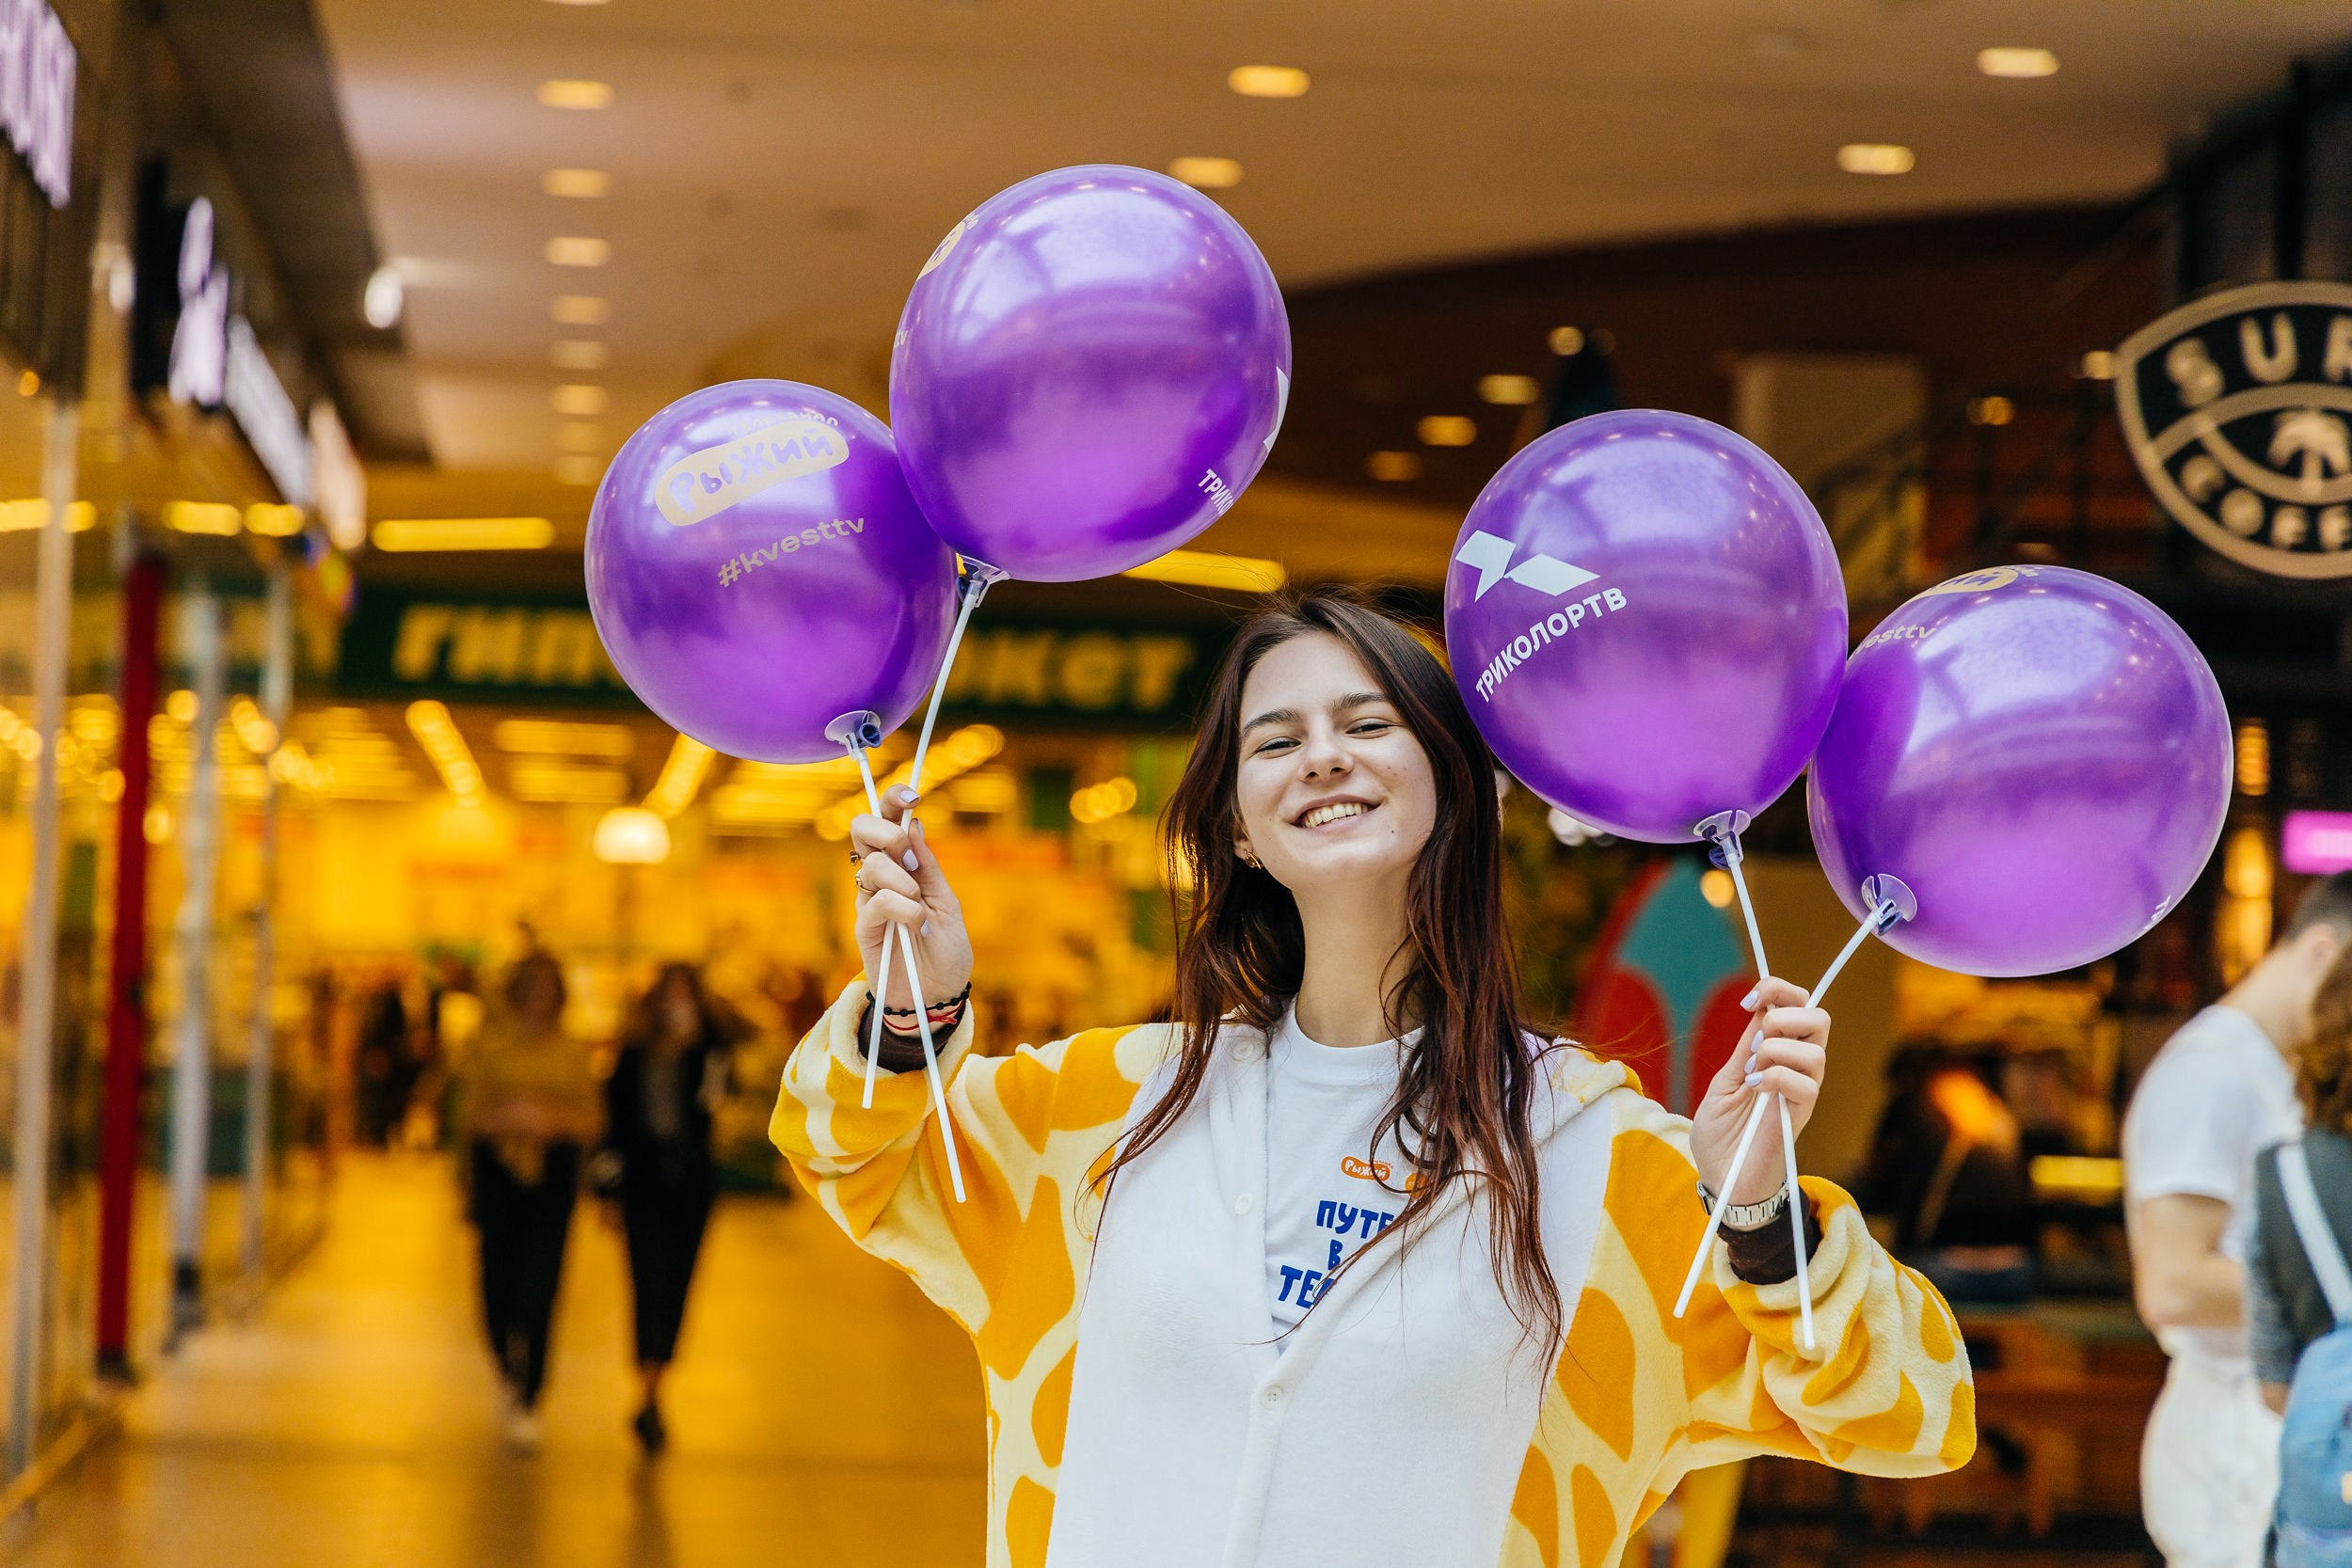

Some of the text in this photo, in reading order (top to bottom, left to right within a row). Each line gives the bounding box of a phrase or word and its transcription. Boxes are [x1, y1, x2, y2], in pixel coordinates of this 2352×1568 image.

[717, 517, 865, 588] #kvesttv
[1475, 587, 1628, 704] ТРИКОЛОРТВ
[1327, 1239, 1343, 1271] В
